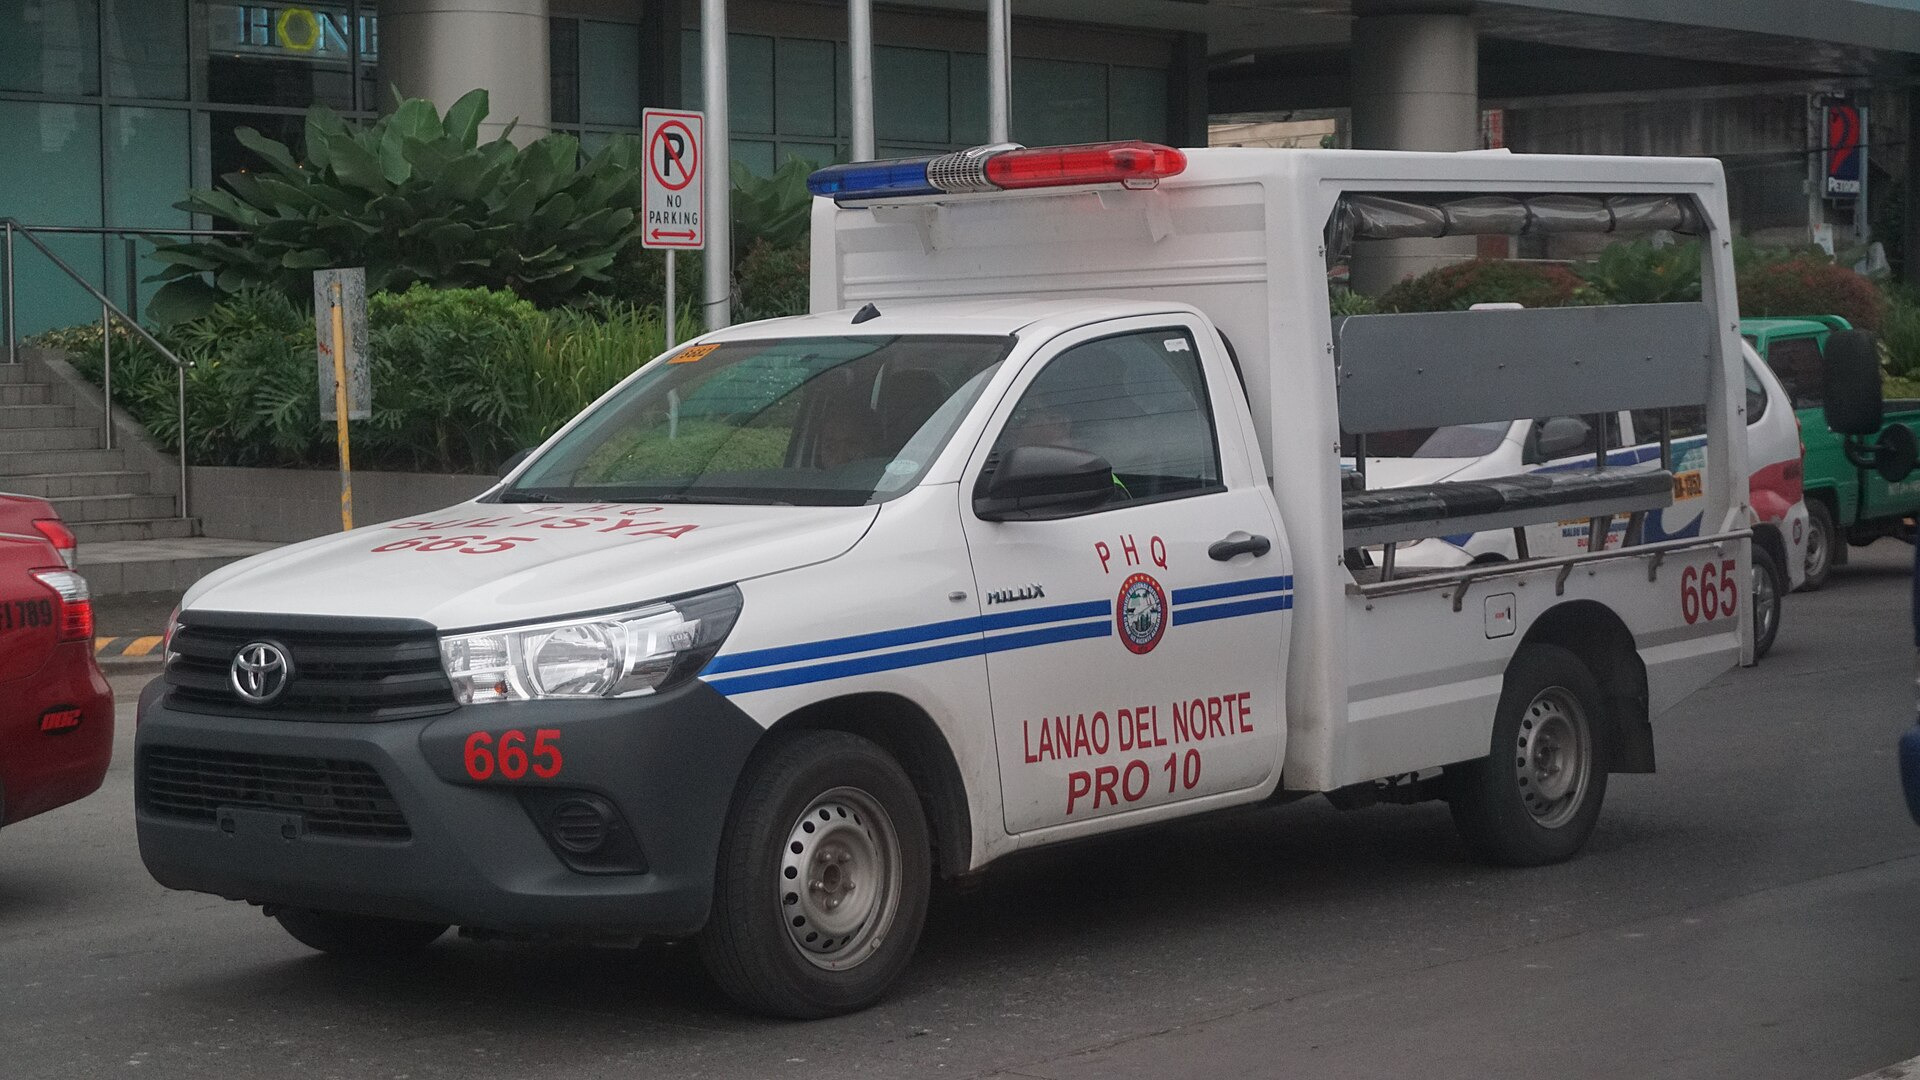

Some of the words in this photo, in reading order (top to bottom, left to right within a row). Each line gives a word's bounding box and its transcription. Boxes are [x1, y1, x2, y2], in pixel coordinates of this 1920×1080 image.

[649, 211, 698, 225] PARKING
[666, 195, 682, 208] NO
[370, 535, 539, 554] 665
[1681, 559, 1737, 625] 665
[15, 599, 53, 628] 789
[1023, 711, 1109, 763] LANAO
[1118, 705, 1167, 751] DEL
[1173, 692, 1253, 744] NORTE
[464, 728, 563, 780] 665
[1066, 759, 1150, 815] PRO
[1164, 748, 1201, 793] 10
